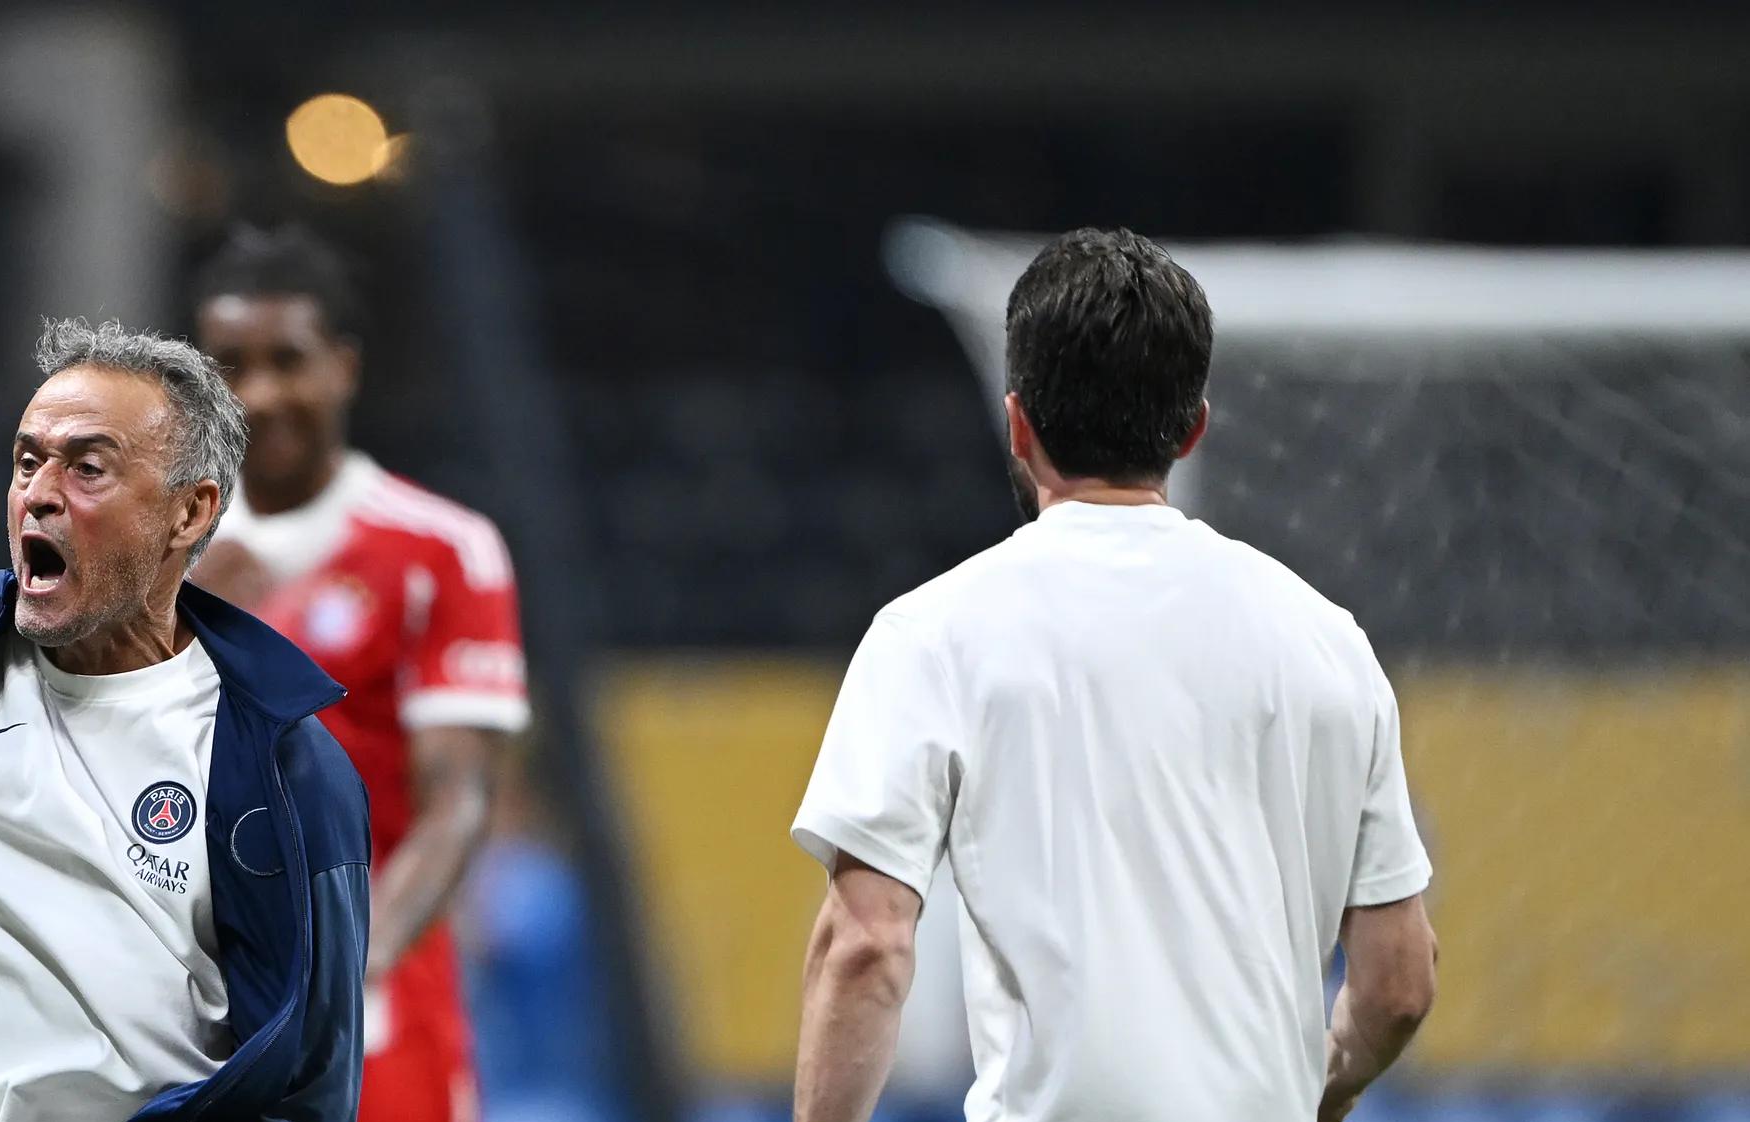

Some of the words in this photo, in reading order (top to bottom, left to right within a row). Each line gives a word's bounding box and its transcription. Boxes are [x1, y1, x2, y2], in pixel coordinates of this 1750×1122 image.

[150, 789, 186, 805] PARIS
[127, 843, 190, 881] QATAR
[135, 868, 187, 895] AIRWAYS
